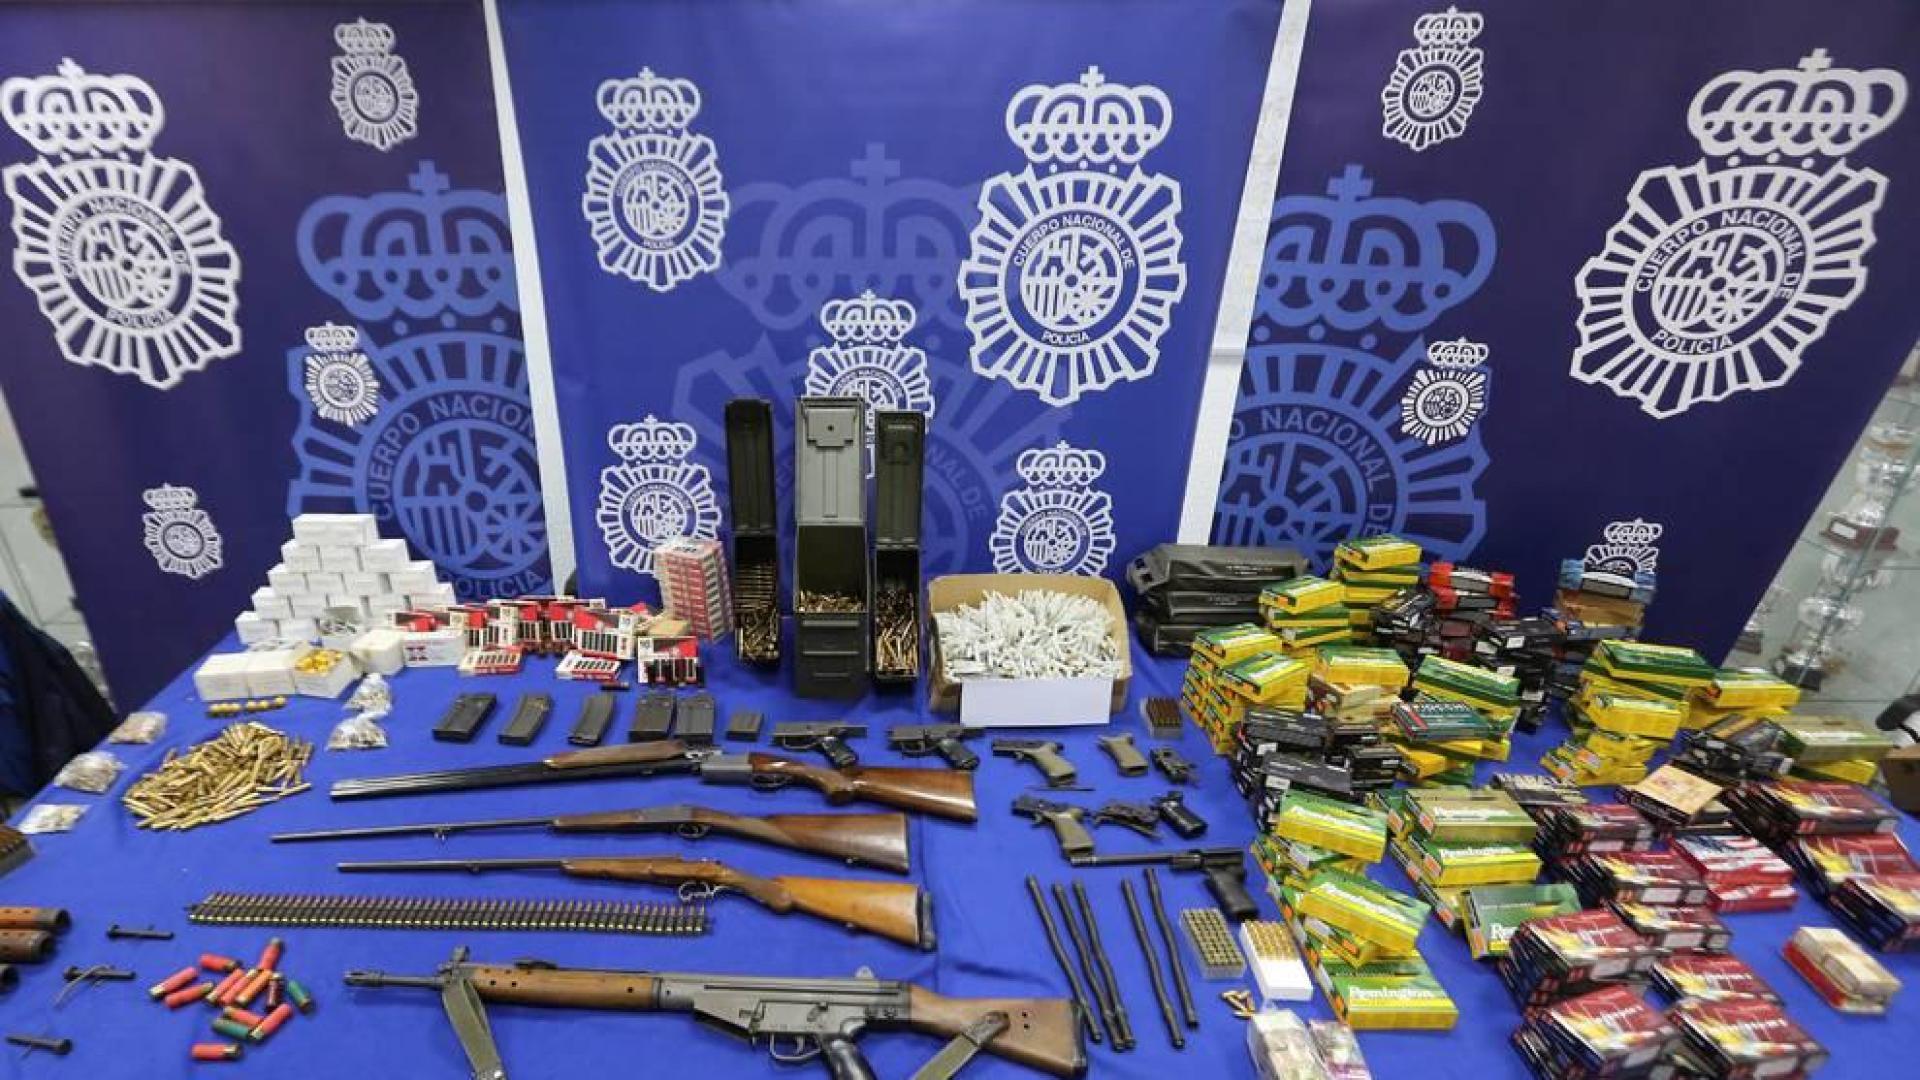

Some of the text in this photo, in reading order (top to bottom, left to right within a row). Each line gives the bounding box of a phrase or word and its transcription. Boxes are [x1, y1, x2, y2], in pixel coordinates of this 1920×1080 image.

[1013, 214, 1136, 271] CUERPO NACIONAL DE
[1636, 209, 1805, 299] CUERPO NACIONAL DE
[1041, 330, 1091, 345] POLICIA
[1652, 329, 1733, 352] POLICIA
[368, 393, 536, 521] CUERPO NACION
[1260, 406, 1393, 537] NACIONAL DE
